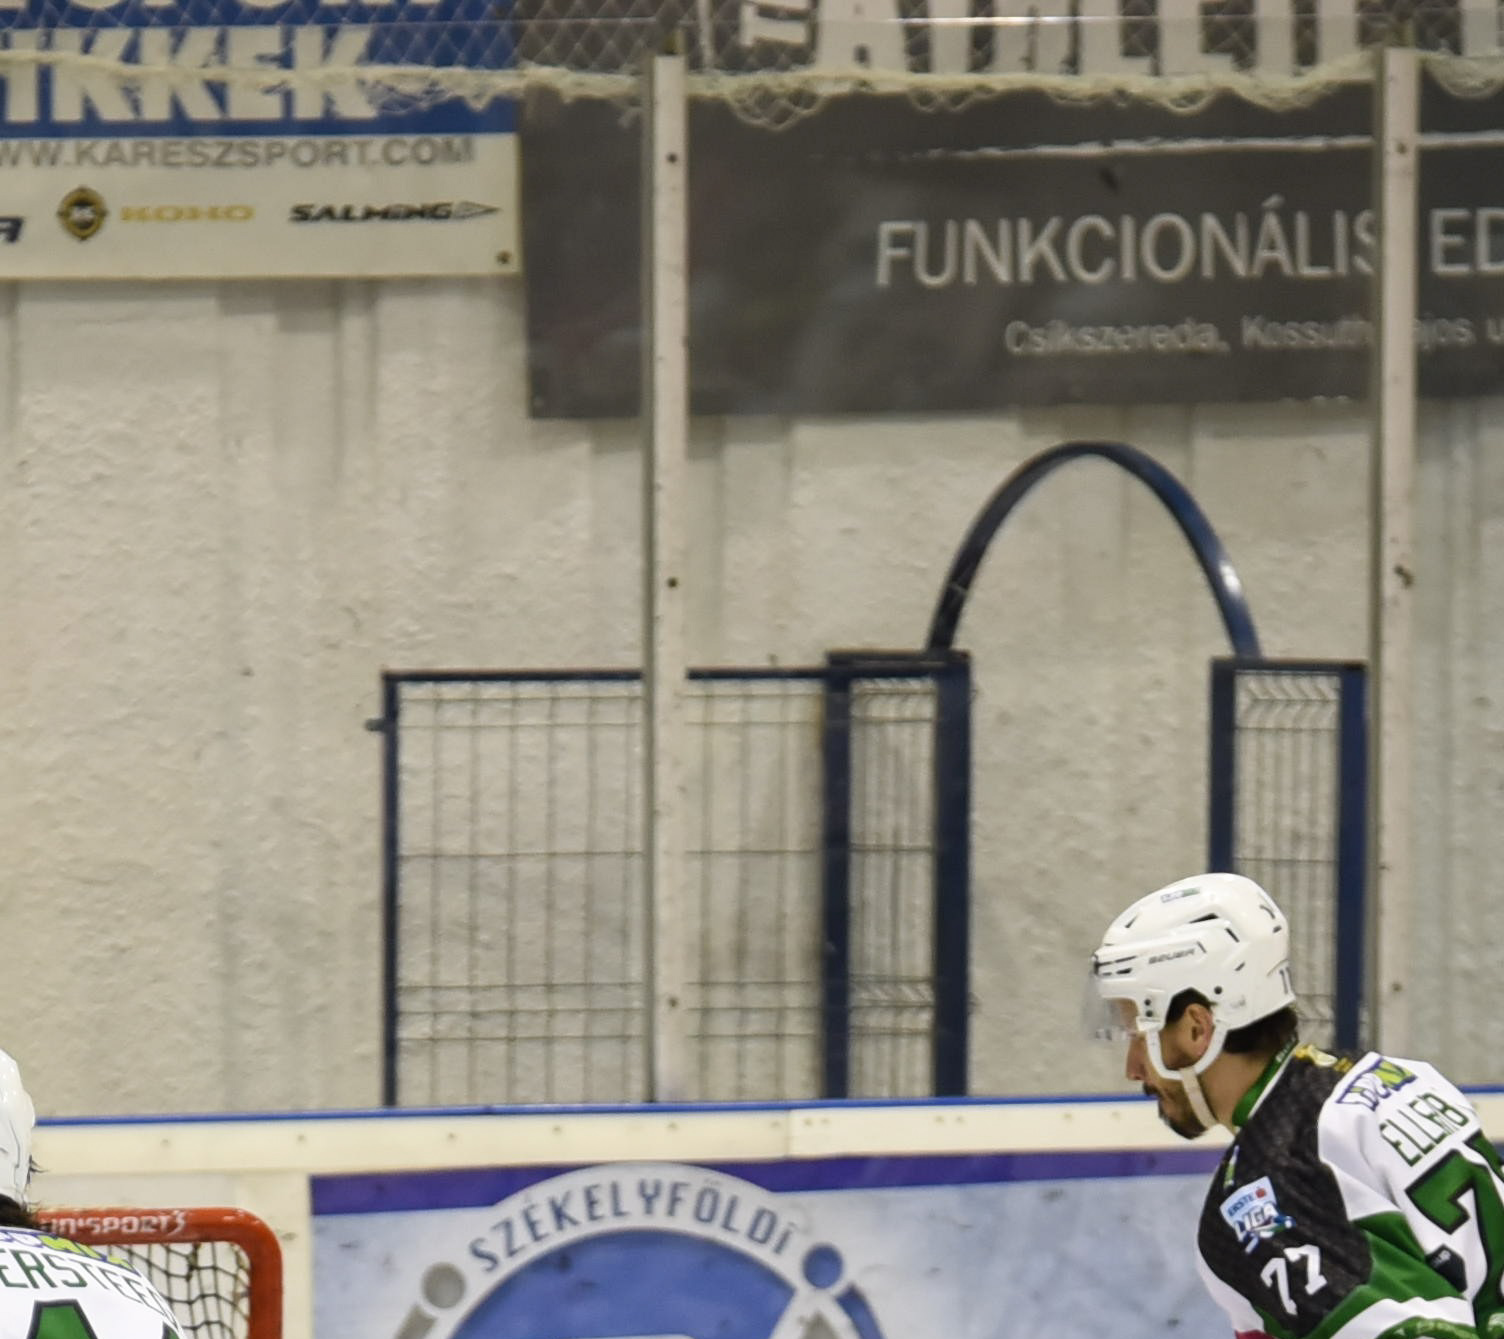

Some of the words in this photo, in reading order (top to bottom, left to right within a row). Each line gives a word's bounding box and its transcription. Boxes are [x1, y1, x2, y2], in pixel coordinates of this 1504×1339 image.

[875, 197, 1376, 288] FUNKCIONÁLIS
[1242, 313, 1377, 350] Kossut
[1414, 318, 1476, 352] ajos
[468, 1177, 796, 1273] SZÉKELYFÖLDI
[1234, 1201, 1279, 1233] LIGA
[1260, 1244, 1328, 1316] 77
